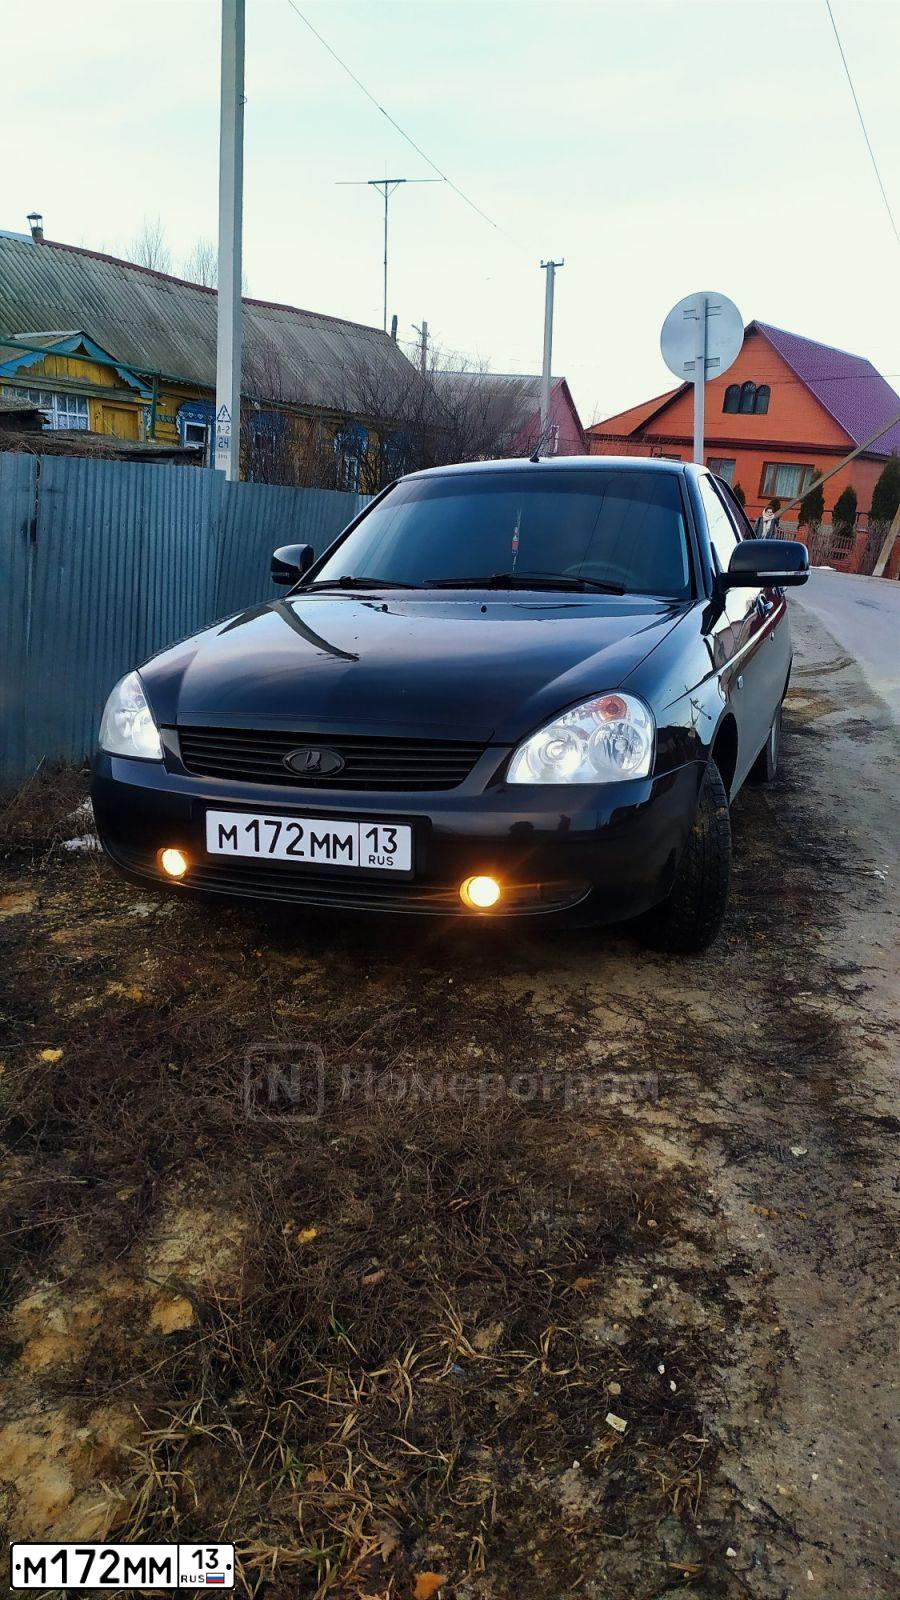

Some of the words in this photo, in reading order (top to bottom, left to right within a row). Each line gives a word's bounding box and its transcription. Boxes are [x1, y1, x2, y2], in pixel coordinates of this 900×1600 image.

[218, 437, 228, 448] 24
[218, 819, 353, 860] М172ММ
[365, 827, 398, 854] 13
[369, 855, 394, 866] RUS
